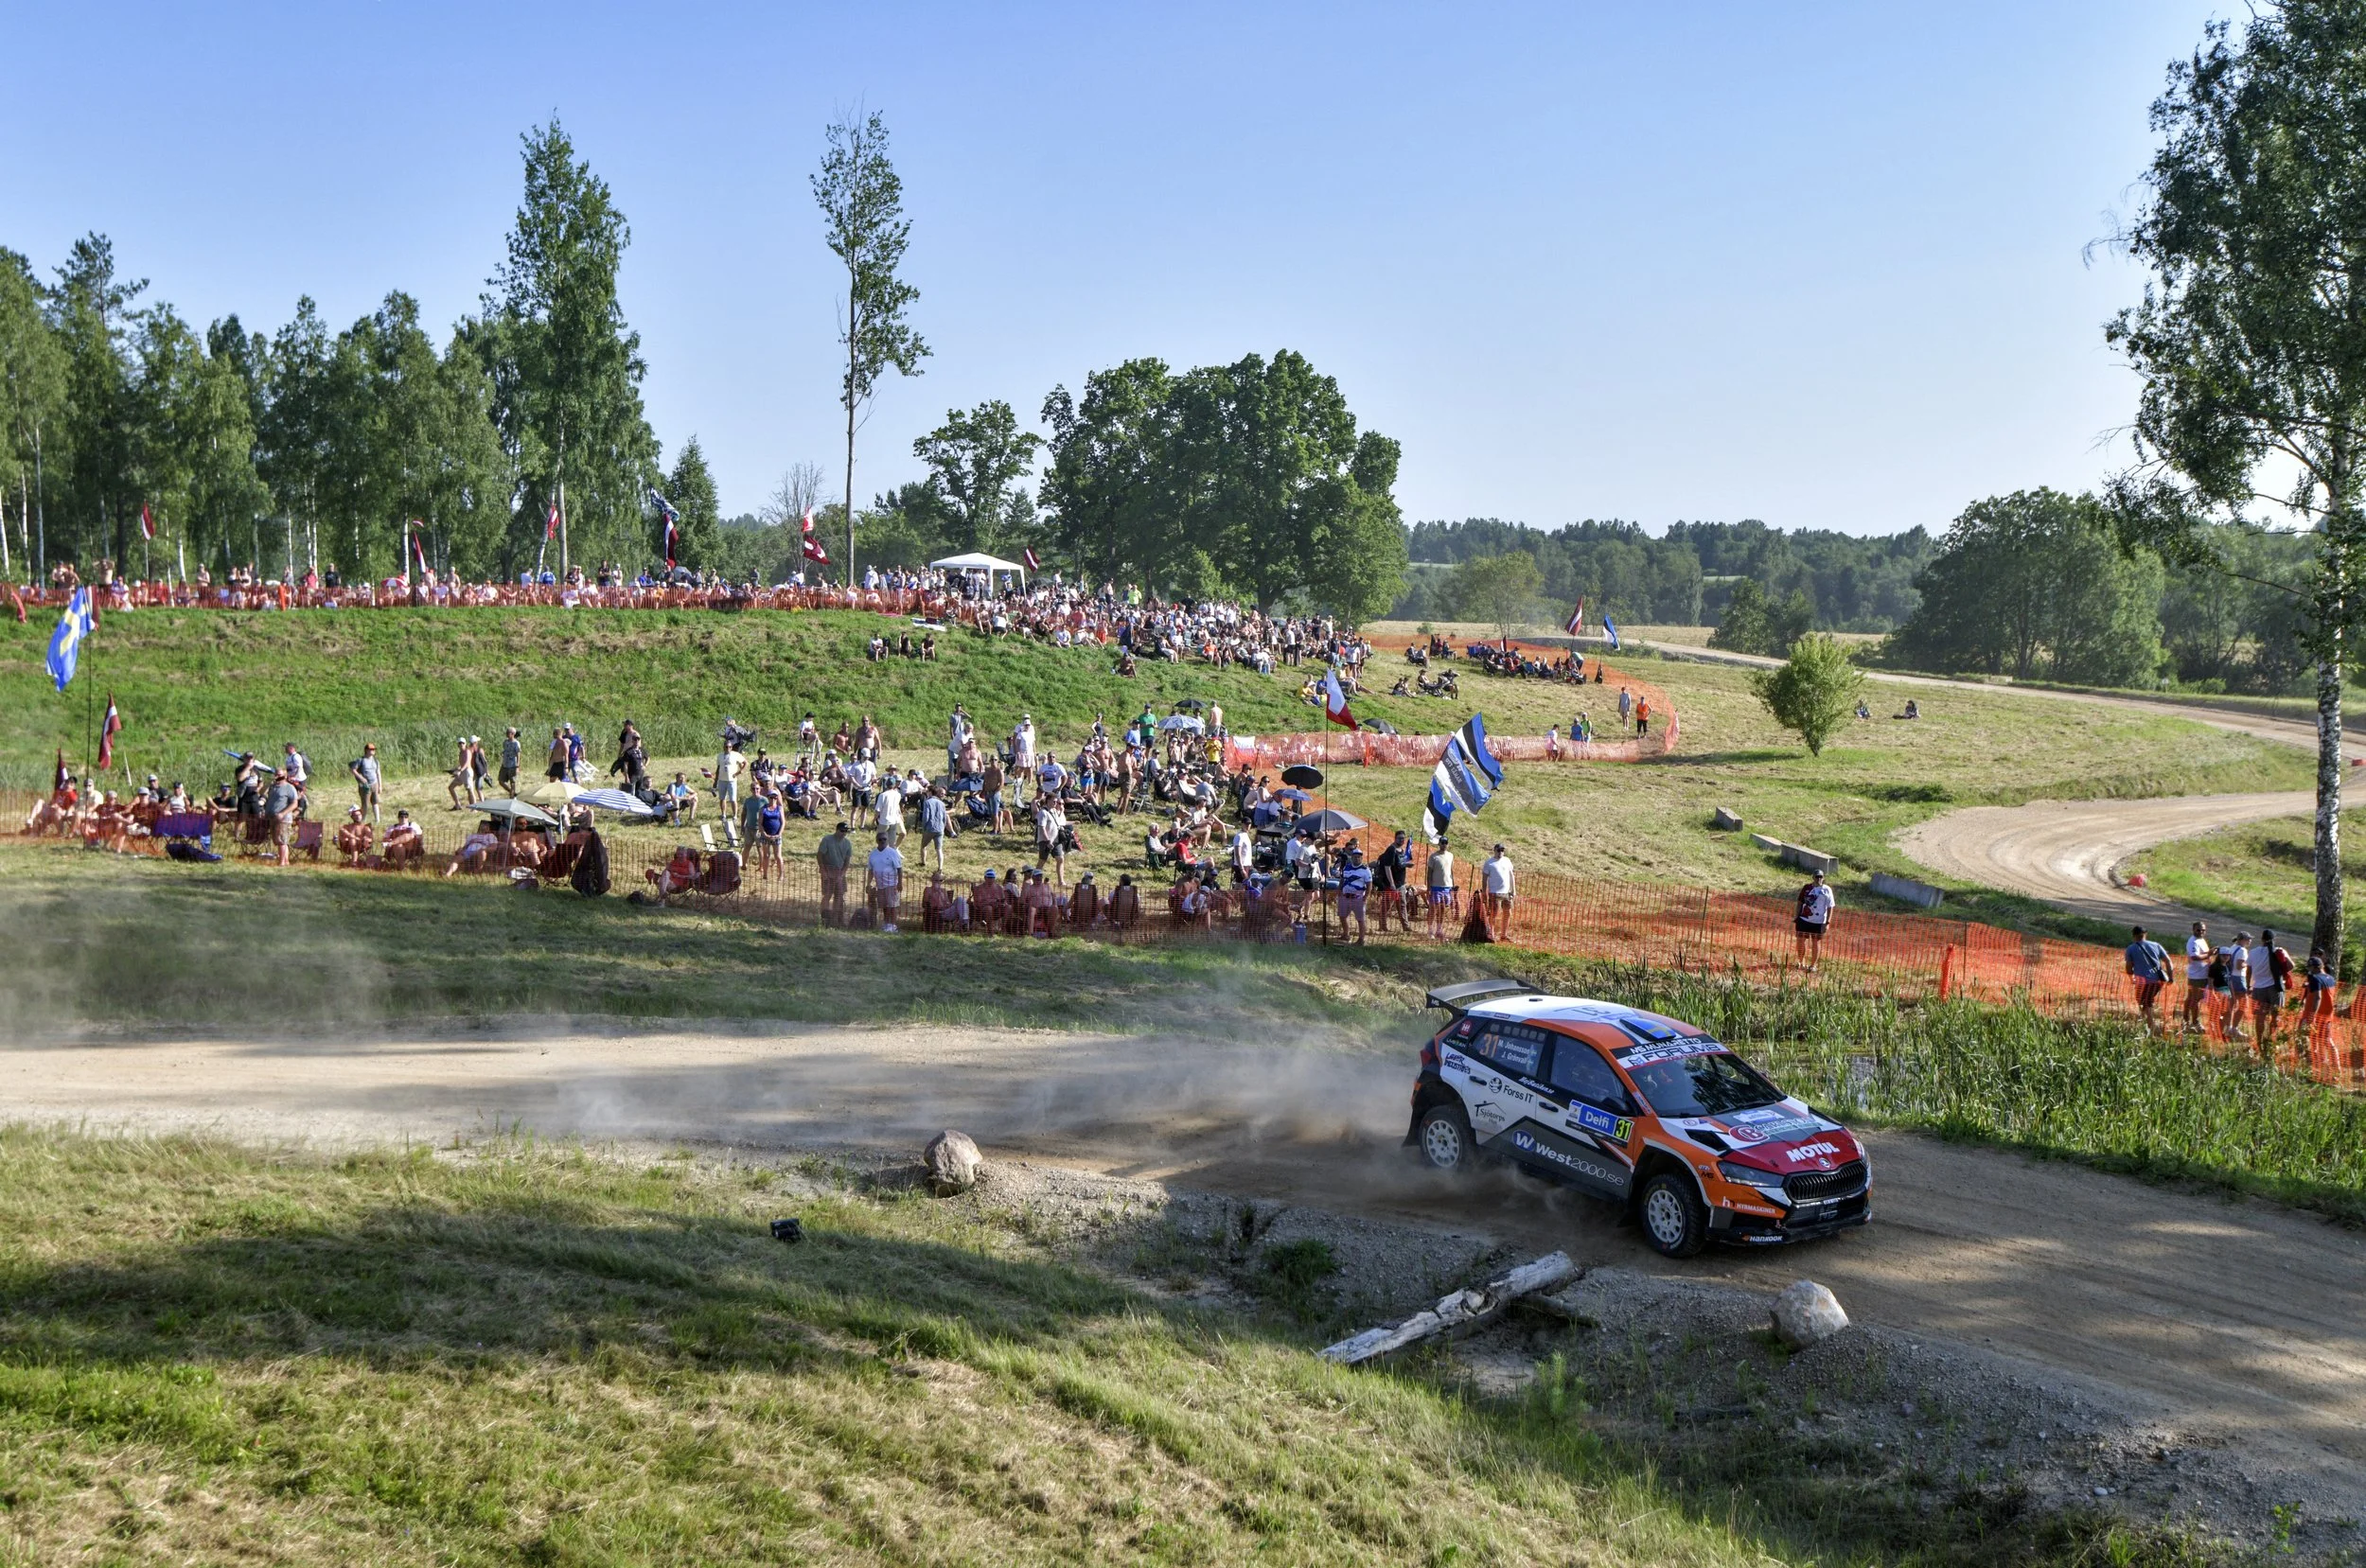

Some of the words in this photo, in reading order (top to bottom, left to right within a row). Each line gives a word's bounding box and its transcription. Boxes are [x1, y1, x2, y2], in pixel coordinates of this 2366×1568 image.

[1479, 1033, 1499, 1058] 31
[1647, 1038, 1702, 1051] MUNARETTO
[1504, 1085, 1524, 1101] Forss
[1525, 1093, 1534, 1104] IT
[1585, 1111, 1609, 1129] Delfi
[1616, 1119, 1632, 1139] 31
[1786, 1141, 1841, 1163] MOTUL
[1737, 1203, 1775, 1214] HYRMASKINER
